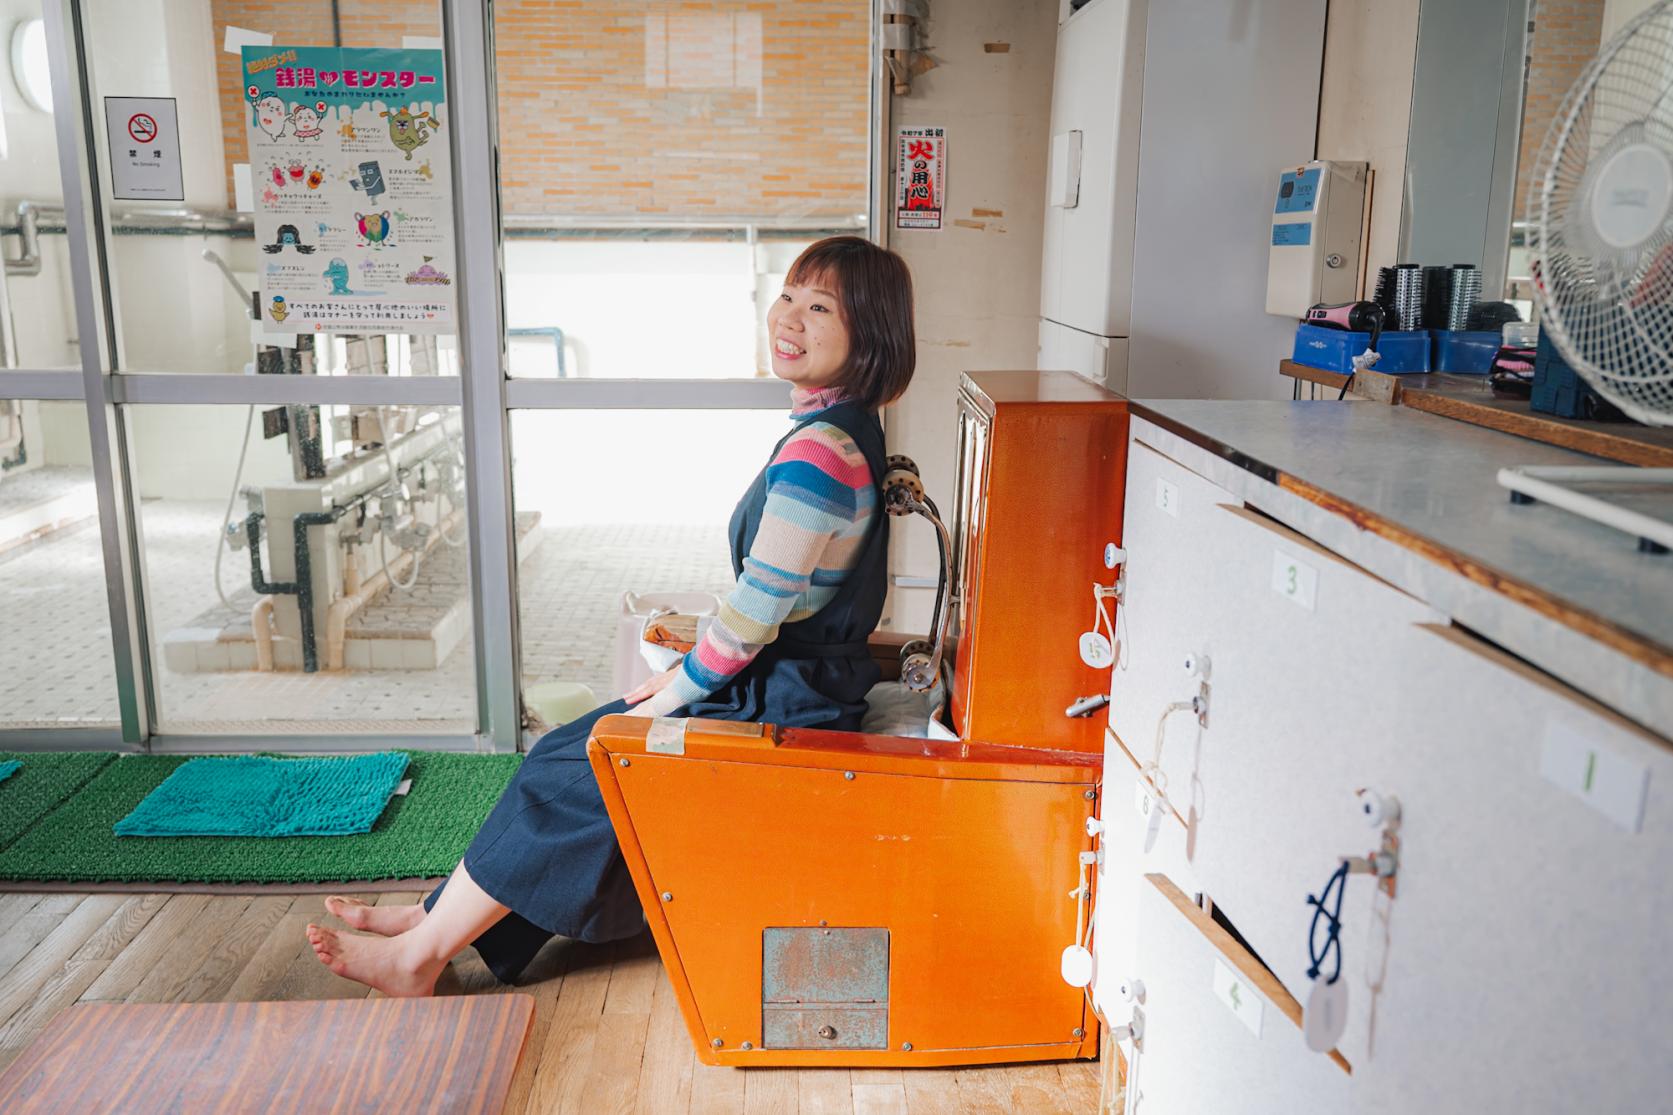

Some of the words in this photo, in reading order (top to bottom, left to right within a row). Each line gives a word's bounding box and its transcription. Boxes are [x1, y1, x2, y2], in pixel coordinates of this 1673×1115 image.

[275, 68, 316, 88] 銭湯
[342, 70, 436, 88] モンスター
[907, 140, 934, 199] 火の用心
[1286, 565, 1298, 595] 3
[1583, 750, 1596, 792] 1
[1229, 981, 1242, 1011] 4
